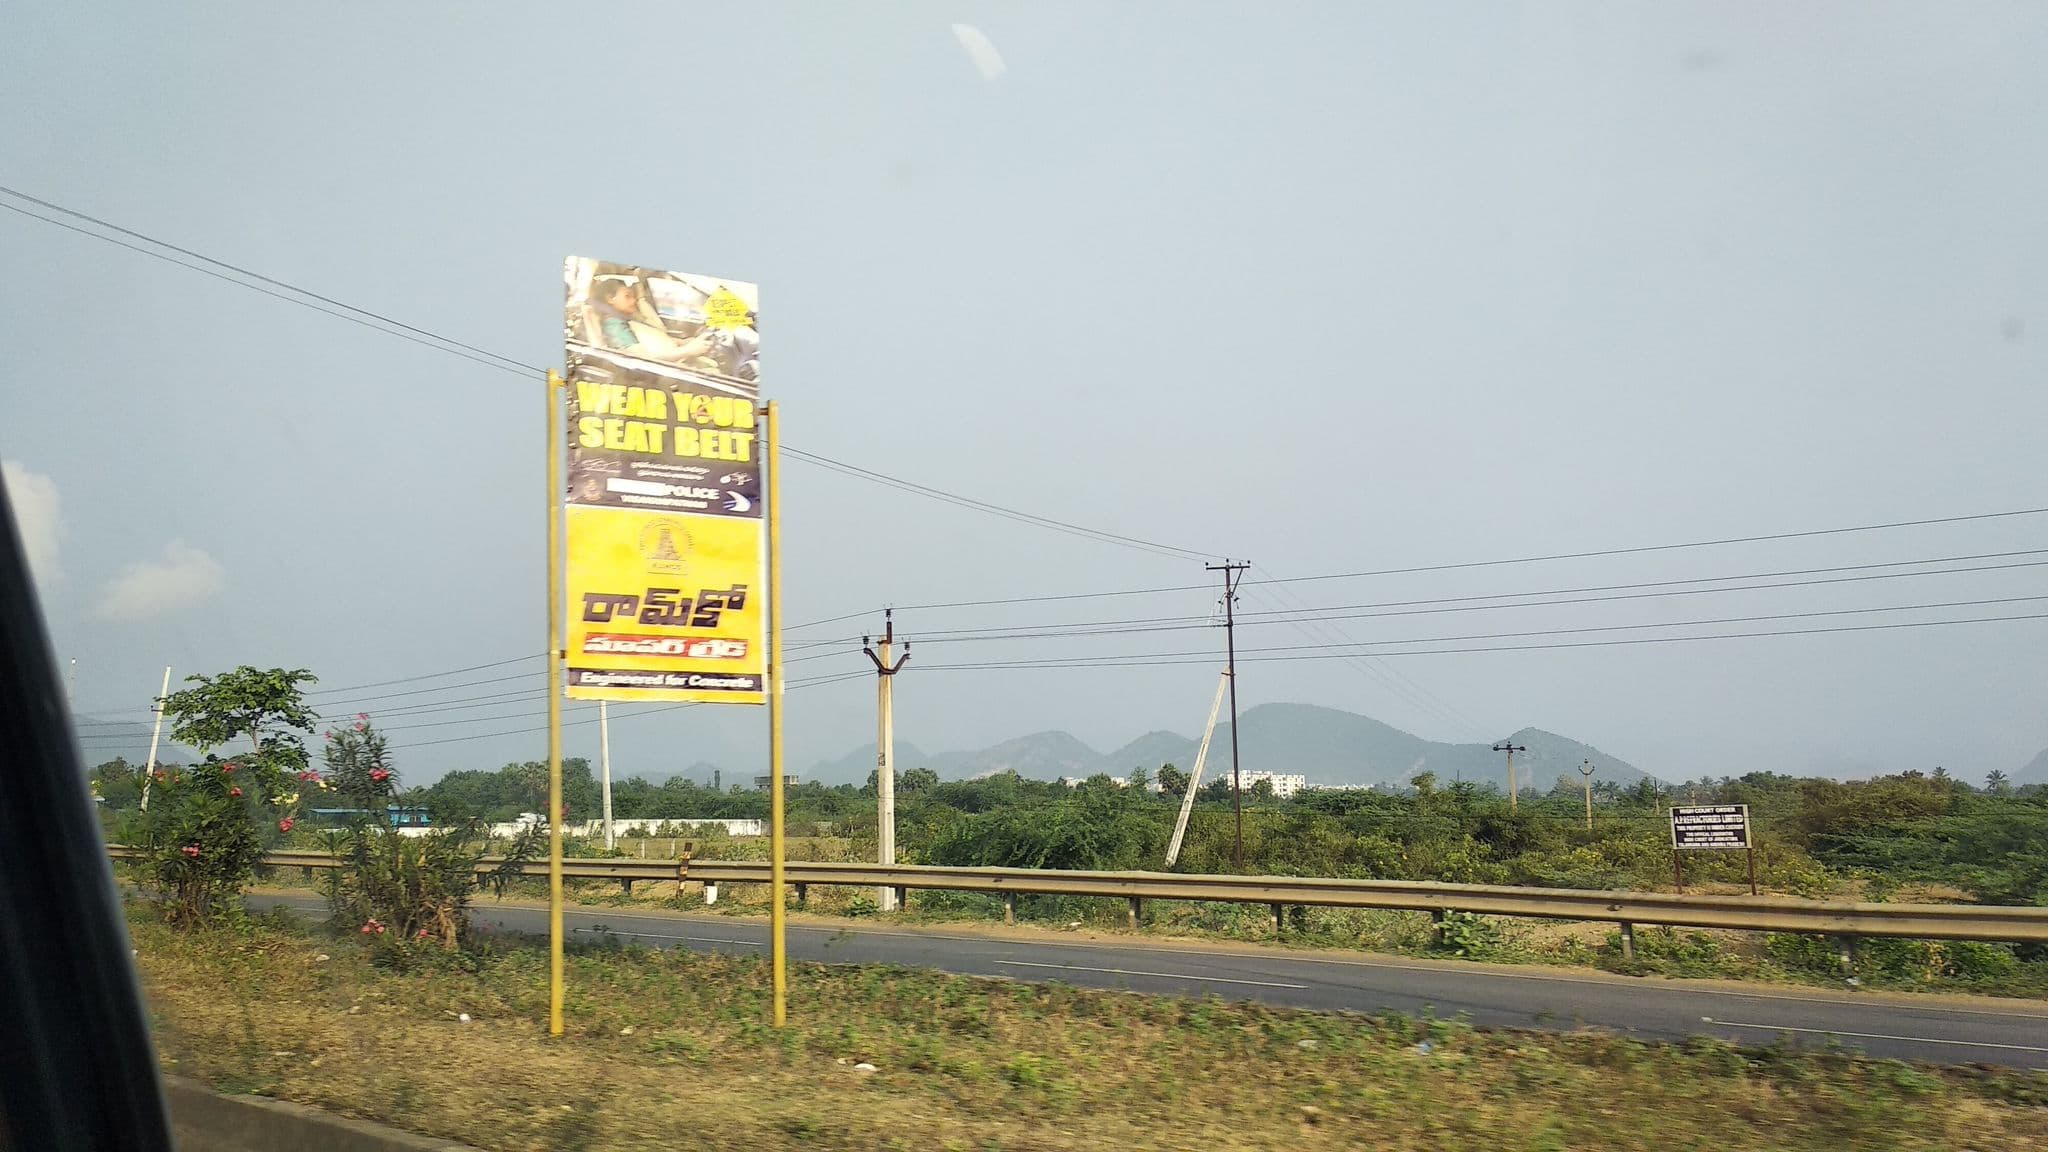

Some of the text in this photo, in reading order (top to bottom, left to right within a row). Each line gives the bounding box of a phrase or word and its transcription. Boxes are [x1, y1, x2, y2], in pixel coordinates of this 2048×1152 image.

[577, 381, 754, 429] WEAR YOUR
[578, 416, 754, 462] SEAT BELT
[663, 483, 720, 500] POLICE
[580, 671, 754, 690] Engineered for Concrete
[1722, 814, 1744, 824] LIMITED
